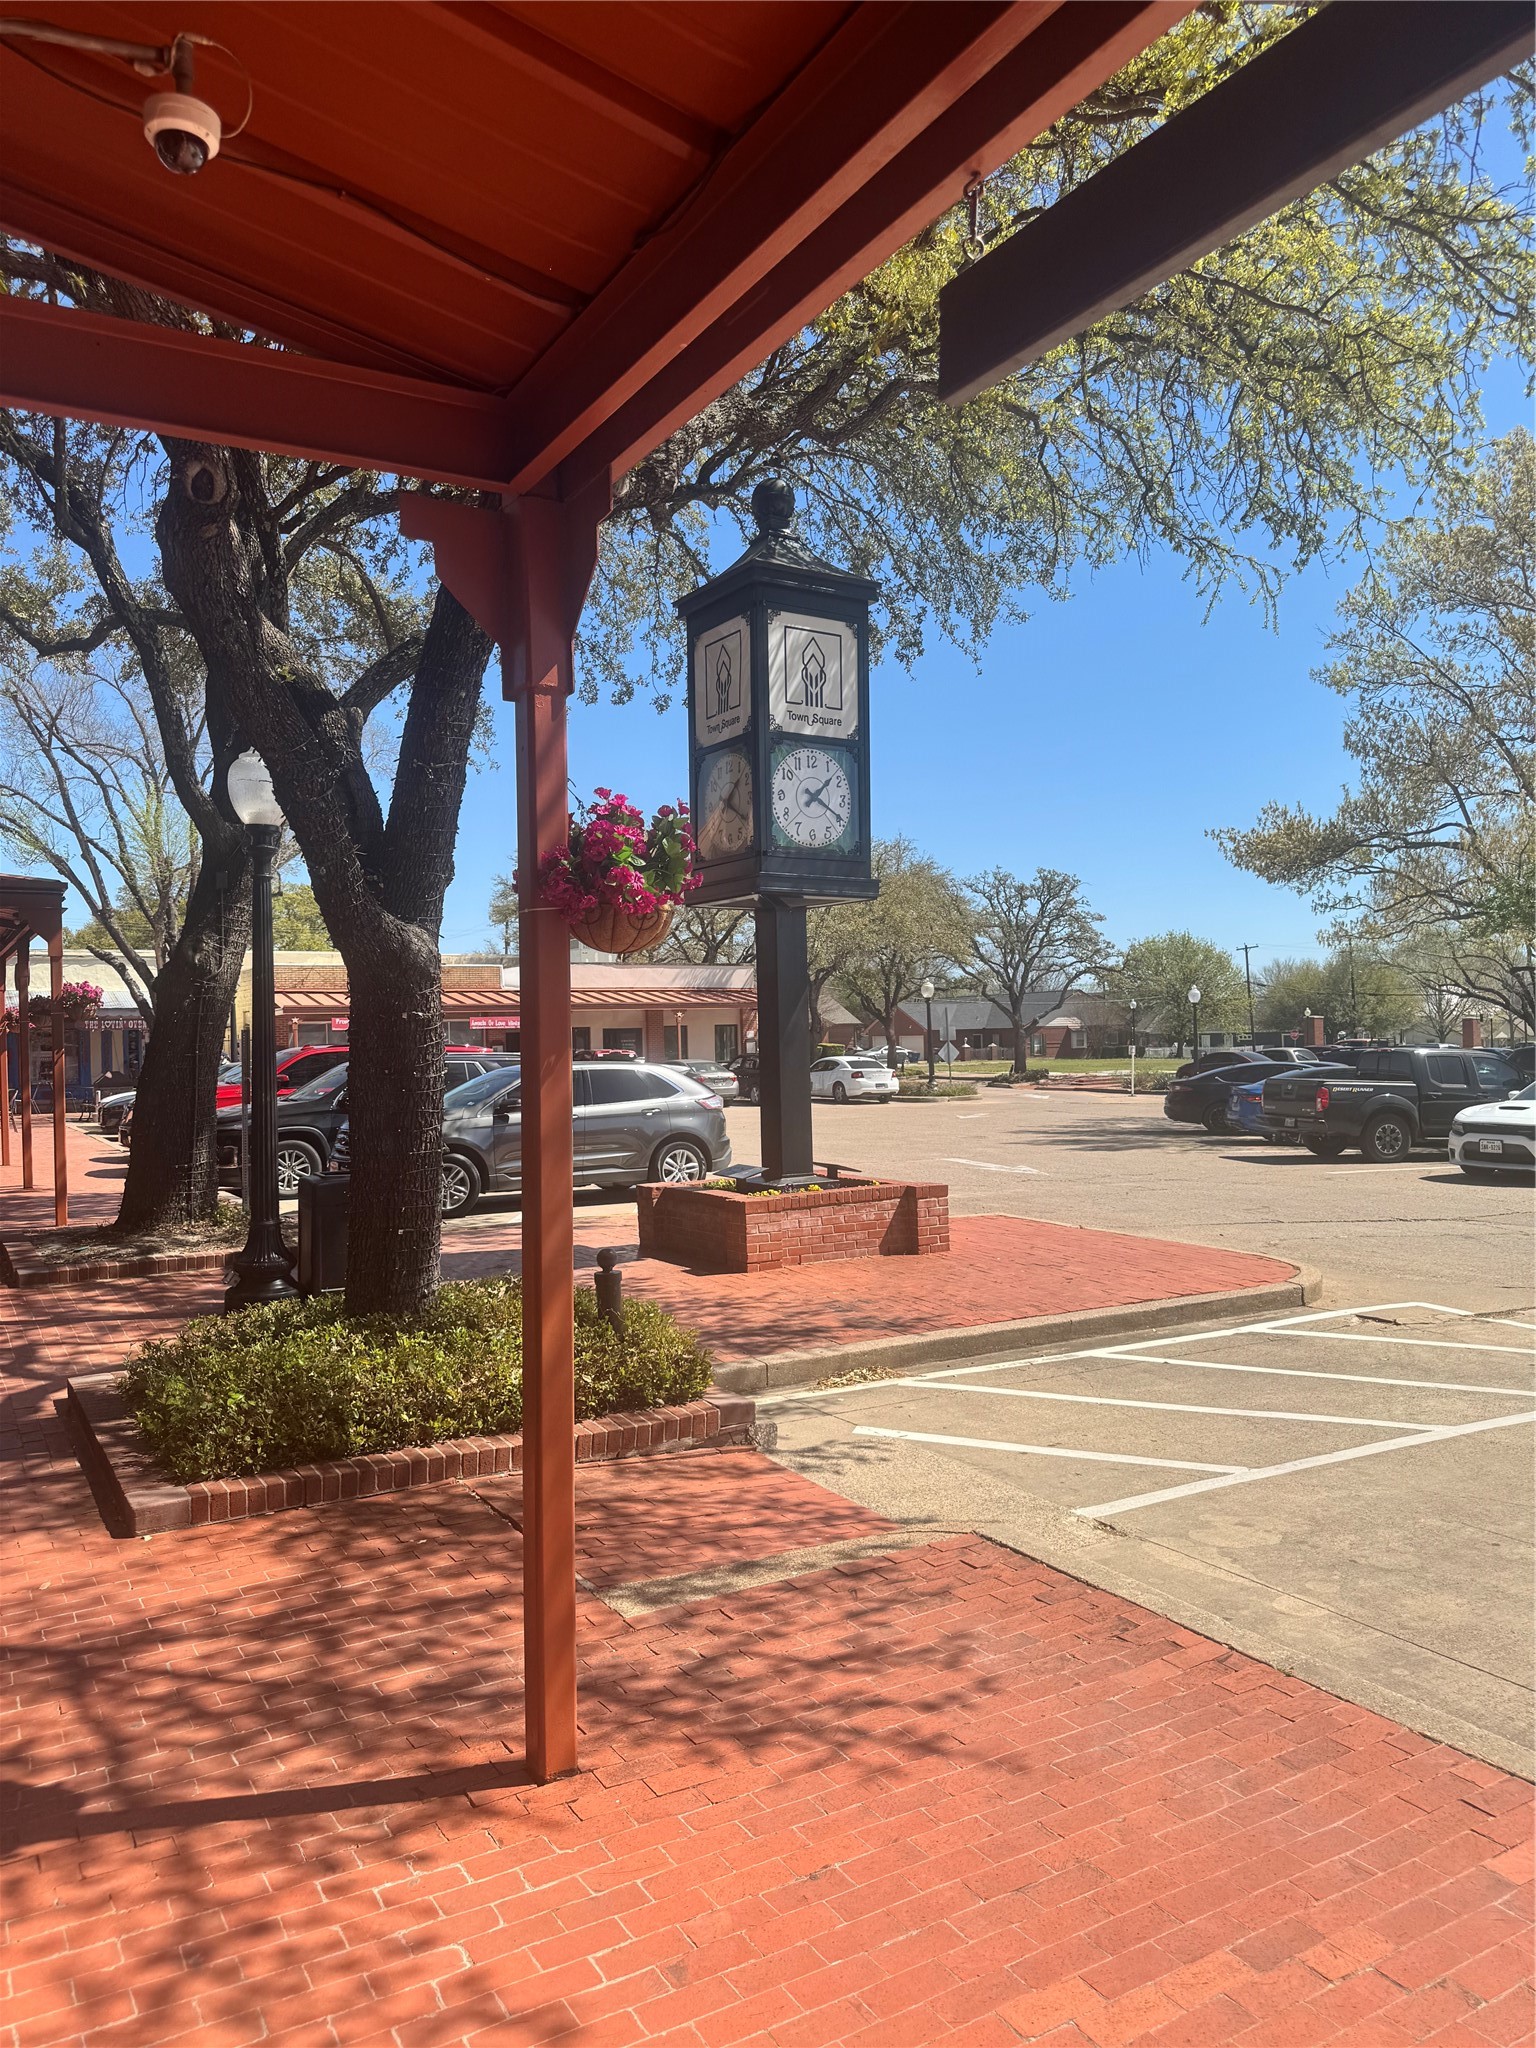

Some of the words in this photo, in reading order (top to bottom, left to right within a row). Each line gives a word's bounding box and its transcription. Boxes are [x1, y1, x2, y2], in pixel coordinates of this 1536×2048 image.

[707, 724, 722, 734] Town
[721, 715, 740, 729] Square
[787, 710, 813, 726] Town
[812, 713, 842, 726] Square
[794, 756, 801, 770] 11
[807, 755, 817, 769] 12
[826, 760, 830, 772] 1
[782, 767, 794, 781] 10
[836, 775, 842, 788] 2
[777, 789, 785, 801] 9
[839, 795, 846, 808] 3
[783, 807, 790, 821] 8
[795, 821, 802, 836] 7
[809, 829, 816, 840] 6
[824, 826, 832, 839] 5
[85, 1020, 98, 1029] THE
[128, 1020, 147, 1029] OVEN
